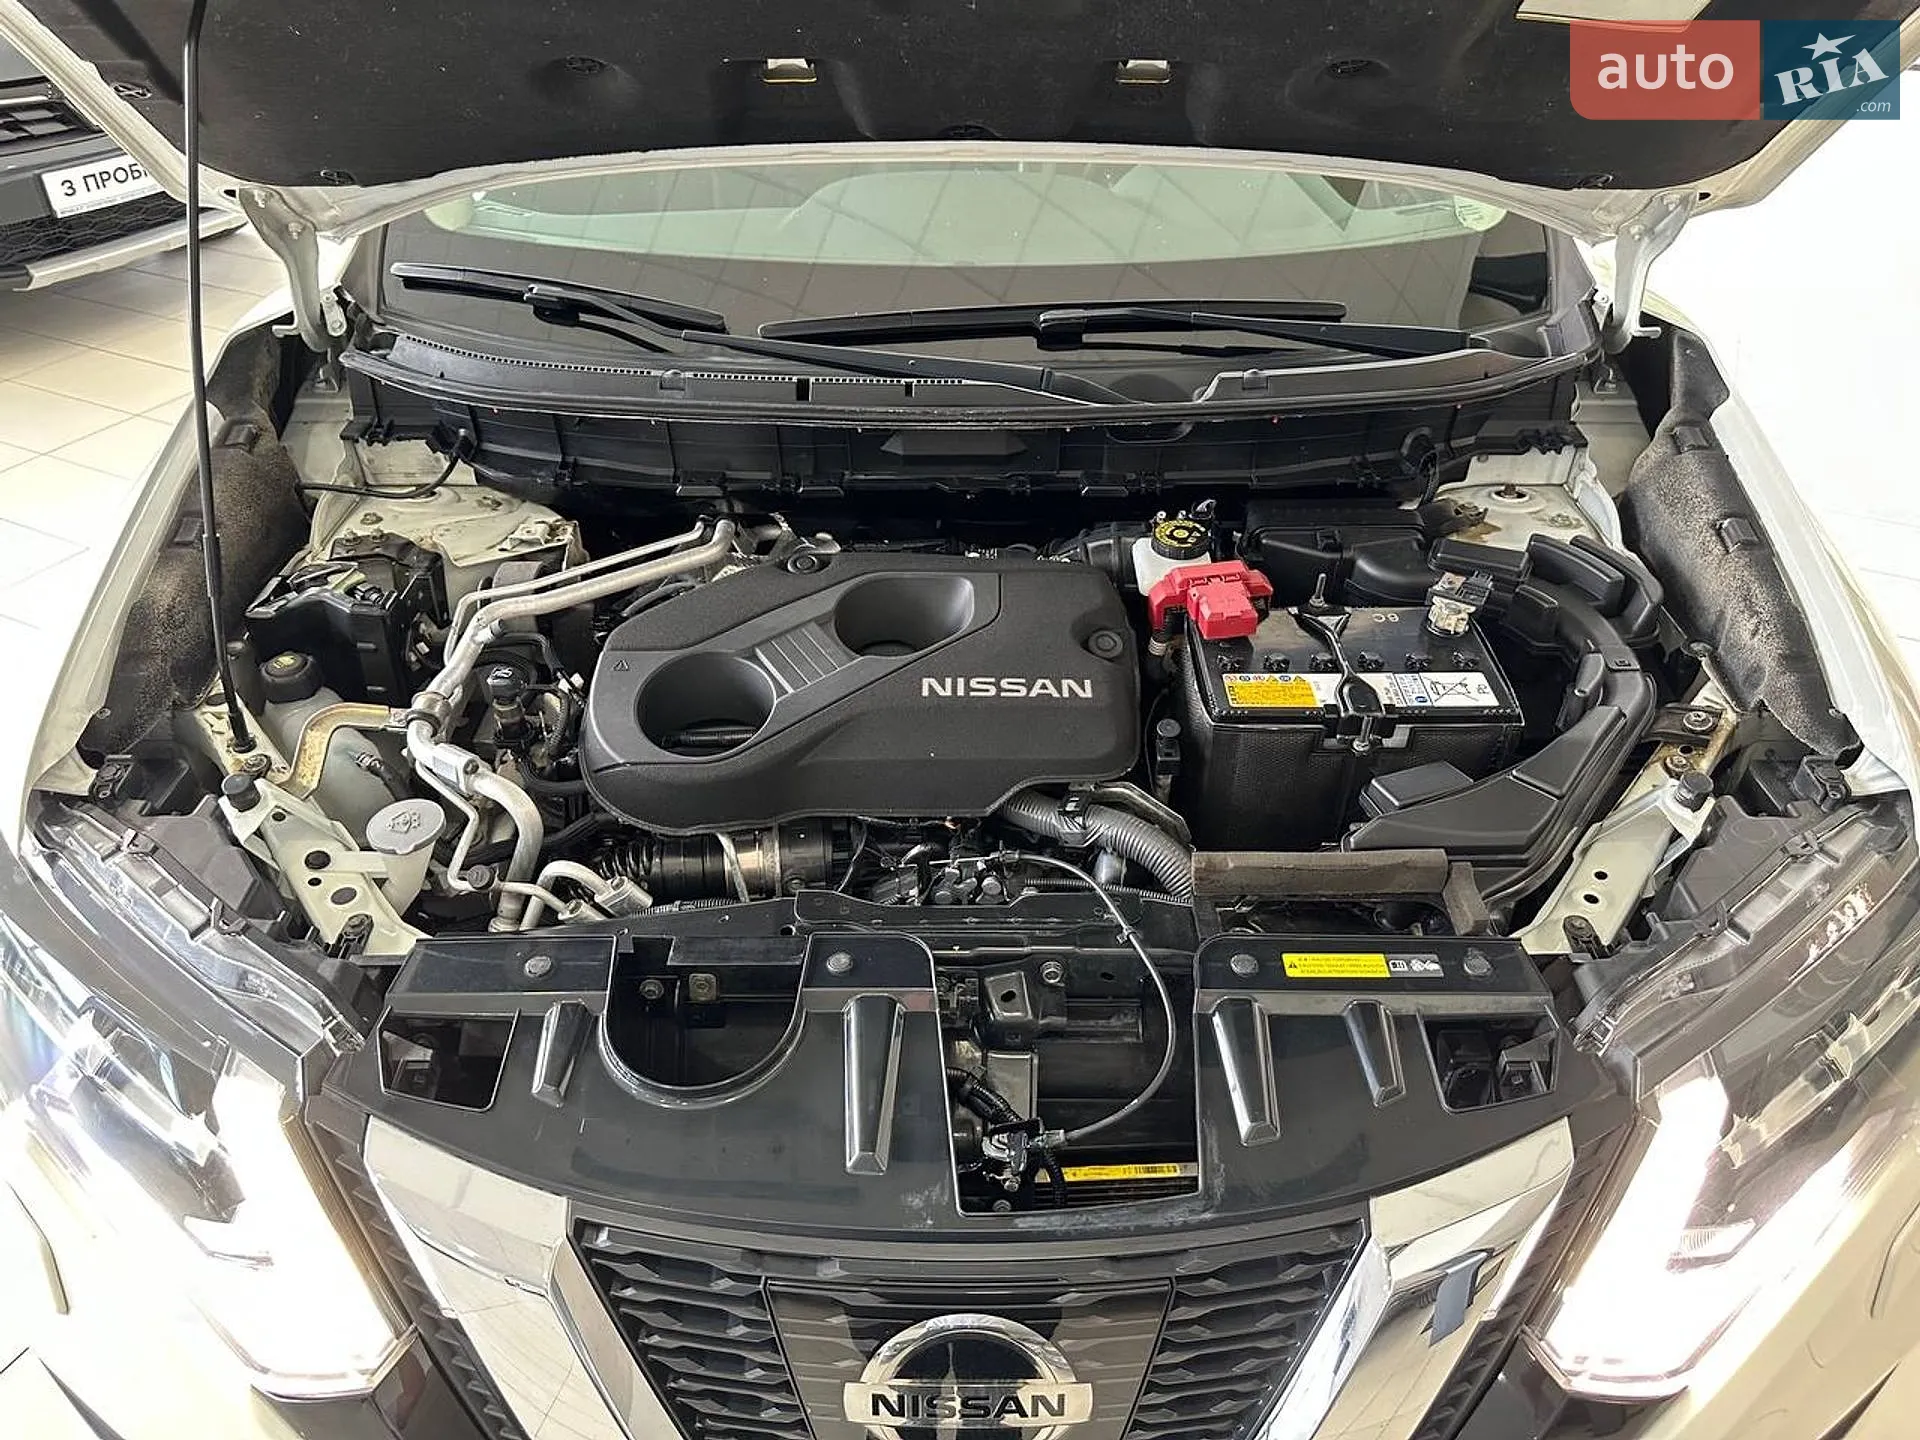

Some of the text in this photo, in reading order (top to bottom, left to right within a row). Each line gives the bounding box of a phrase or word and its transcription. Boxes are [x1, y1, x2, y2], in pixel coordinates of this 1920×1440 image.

[82, 162, 149, 193] ПРОБ
[920, 676, 1093, 699] NISSAN
[870, 1392, 1065, 1419] NISSAN
